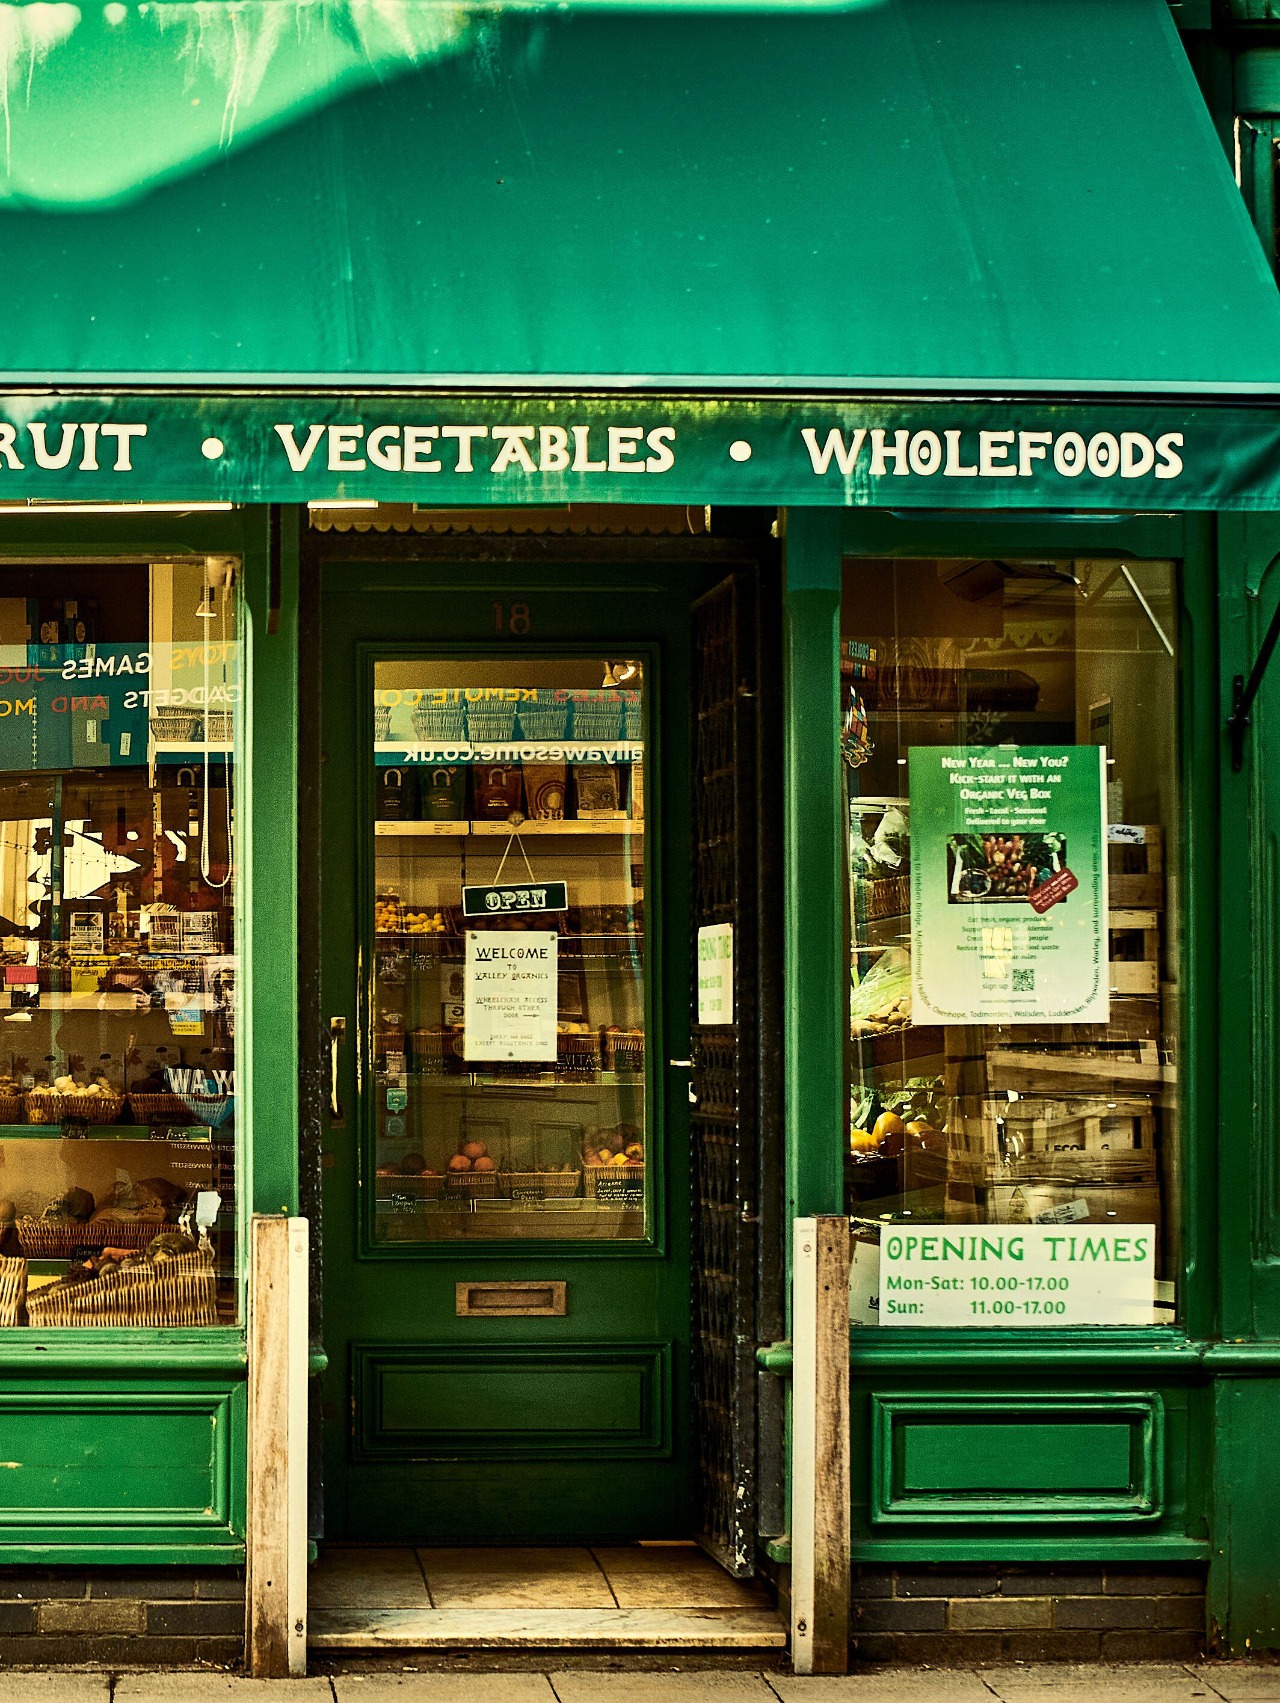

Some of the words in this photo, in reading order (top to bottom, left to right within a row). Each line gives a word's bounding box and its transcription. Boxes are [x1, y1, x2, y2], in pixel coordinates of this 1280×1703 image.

[274, 423, 676, 474] VEGETABLES
[802, 427, 1186, 480] WHOLEFOODS
[492, 600, 531, 635] 18
[485, 888, 548, 911] OPEN
[475, 947, 548, 961] WELCOME
[475, 972, 508, 980] VALLEY
[511, 972, 549, 980] ORGANICS
[886, 1236, 1024, 1260] OPENING
[1043, 1237, 1148, 1262] TIMES
[887, 1276, 965, 1291] Mon-Sat:
[970, 1276, 1069, 1291] 10.00-17.00
[887, 1300, 924, 1315] Sun:
[970, 1300, 1066, 1315] 11.00-17.00
